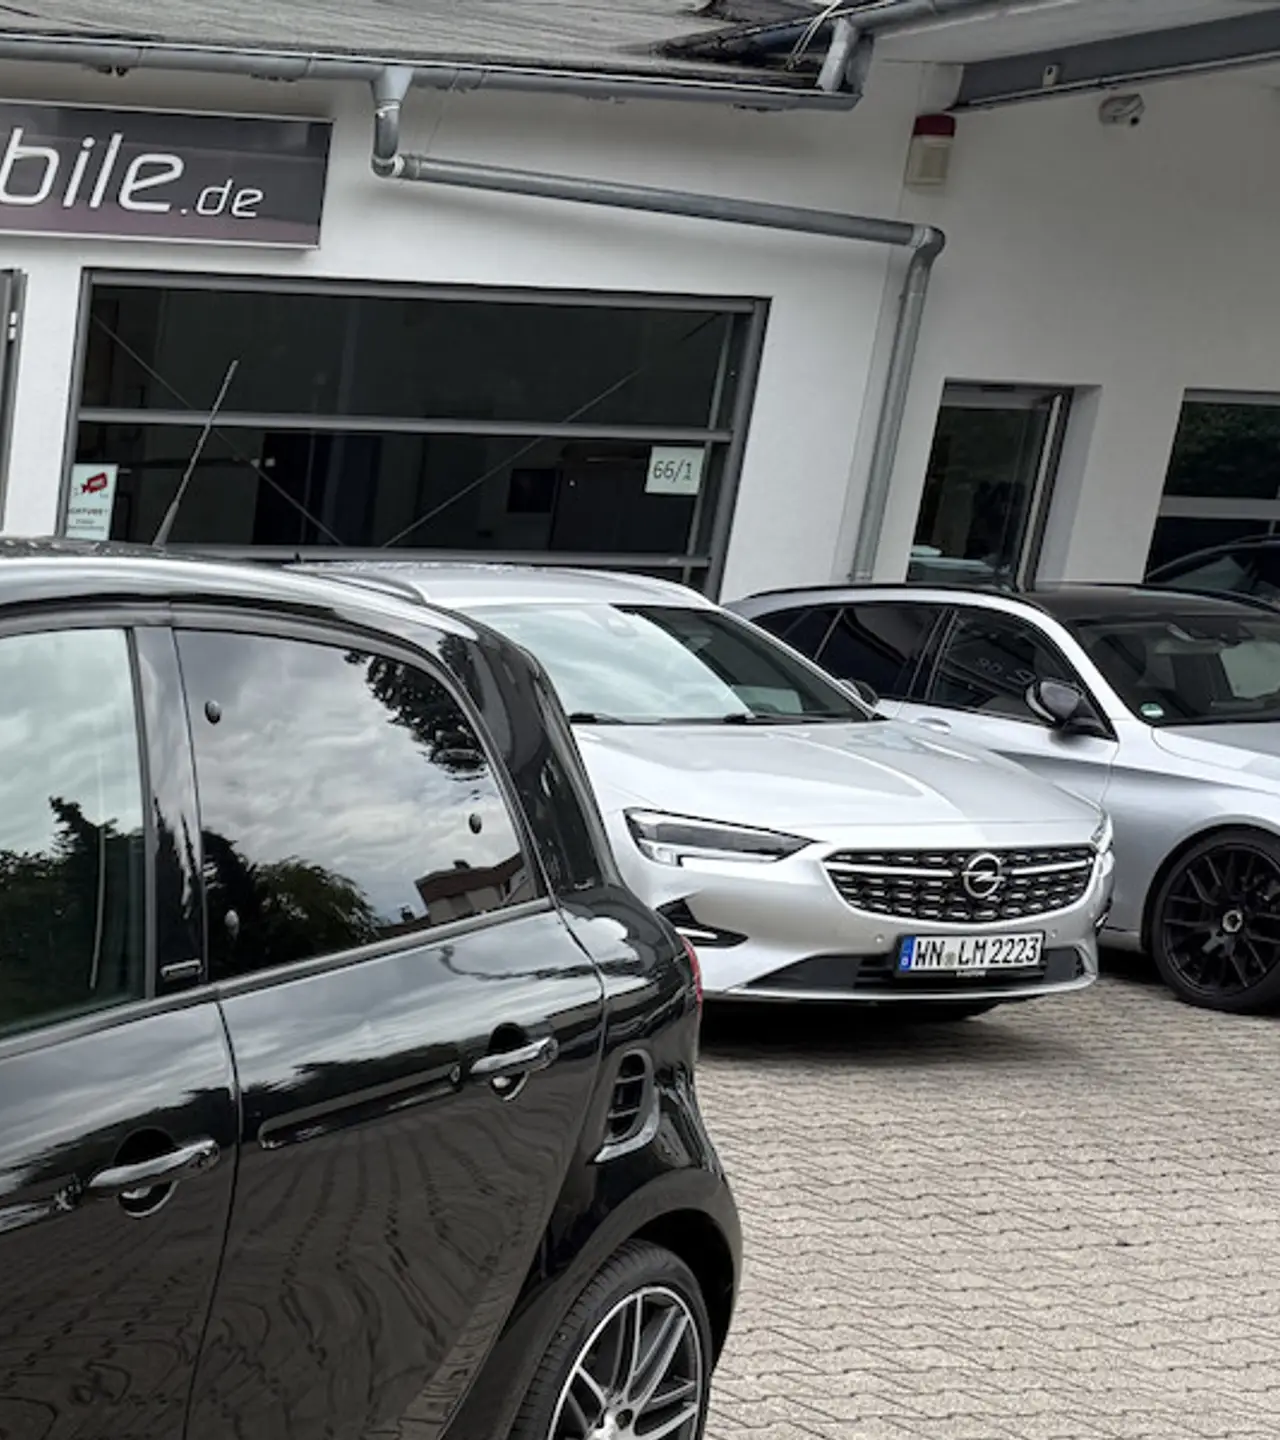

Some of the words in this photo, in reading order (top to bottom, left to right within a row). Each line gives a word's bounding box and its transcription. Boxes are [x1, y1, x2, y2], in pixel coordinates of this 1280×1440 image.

[653, 459, 693, 483] 66/1
[959, 940, 988, 965] LM
[990, 938, 1039, 964] 2223
